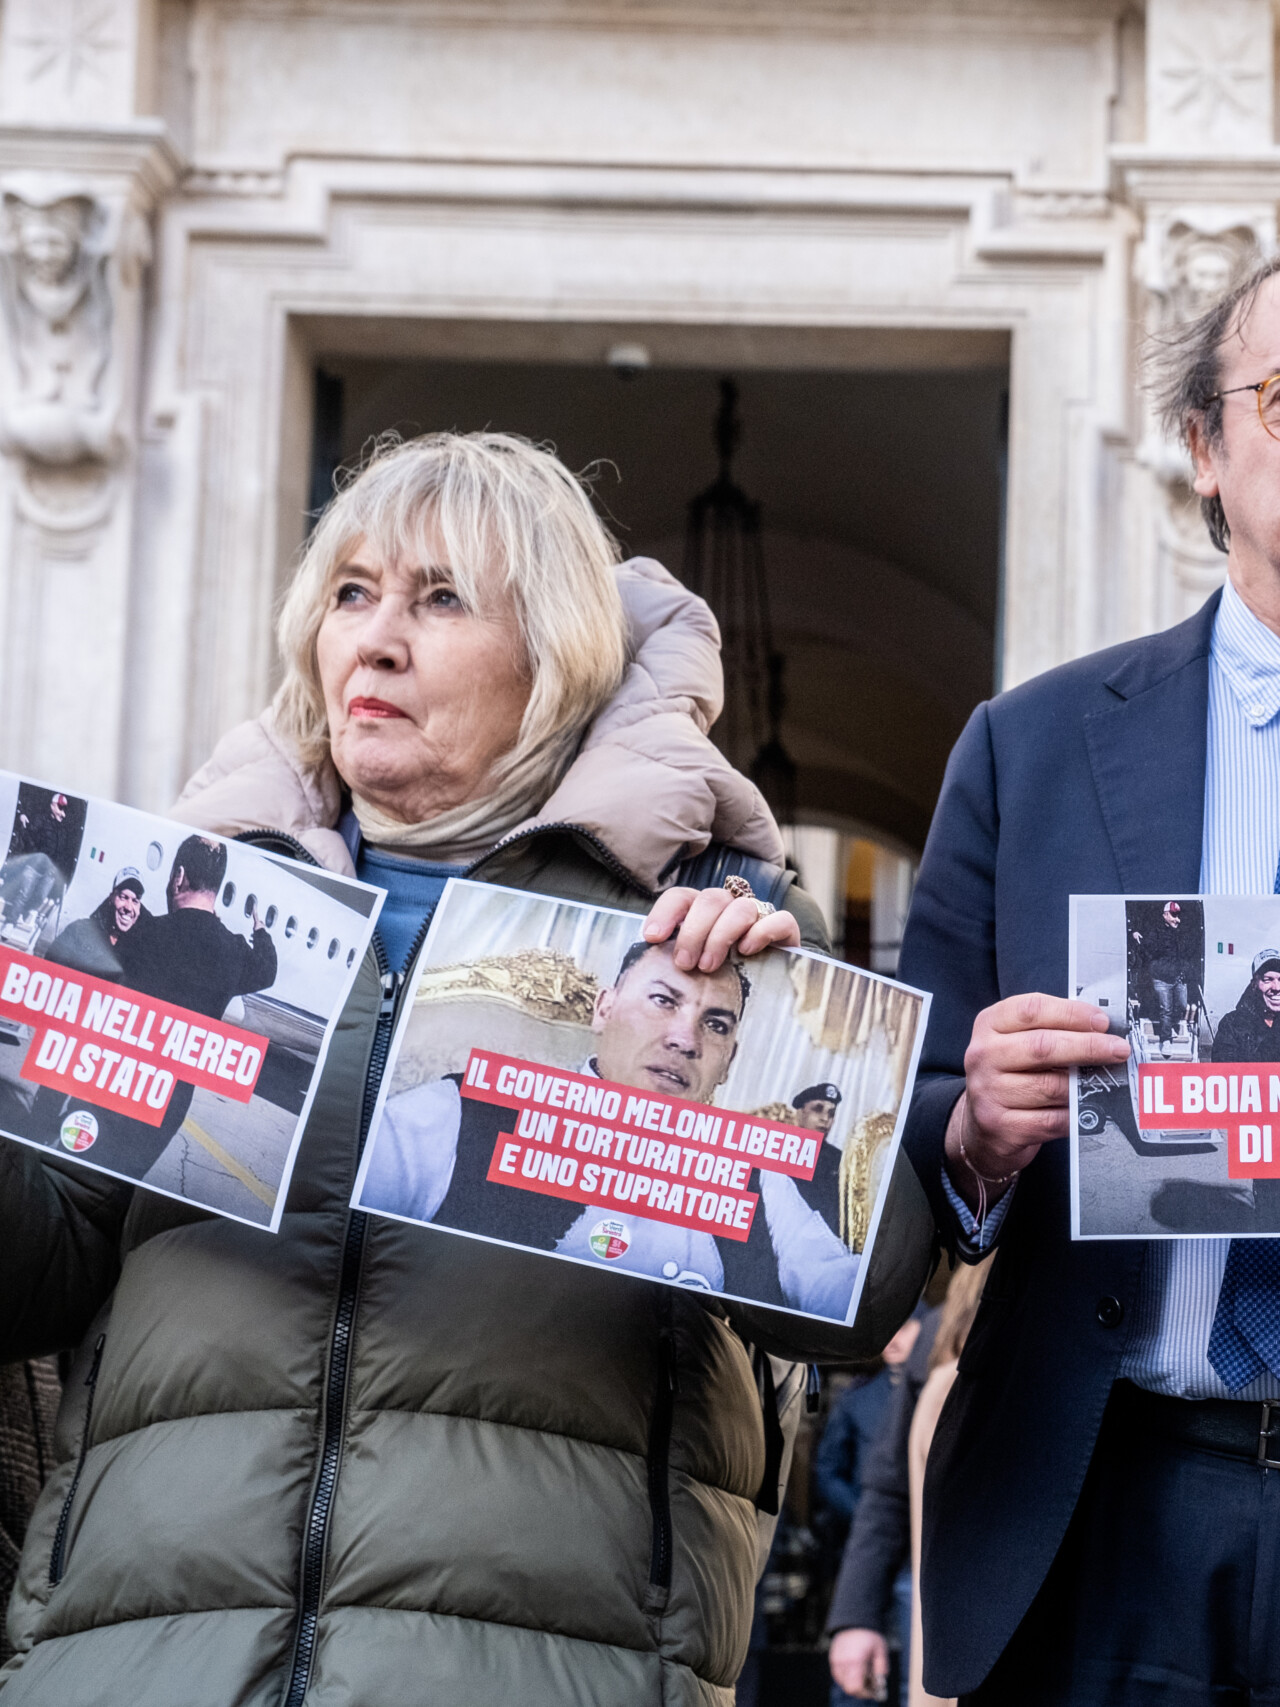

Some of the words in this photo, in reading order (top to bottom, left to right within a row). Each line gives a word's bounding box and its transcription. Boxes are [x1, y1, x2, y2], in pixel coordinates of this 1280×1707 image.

[0, 962, 84, 1024] BOIA
[80, 990, 262, 1086] NELL'AEREO
[34, 1028, 78, 1075] DI
[72, 1042, 174, 1110] STATO
[1142, 1075, 1175, 1114] IL
[1181, 1075, 1263, 1114] BOIA
[466, 1057, 491, 1090] IL
[495, 1065, 622, 1121] GOVERNO
[622, 1095, 723, 1146] MELONI
[722, 1120, 818, 1169] LIBERA
[517, 1108, 559, 1144] UN
[561, 1118, 751, 1191] TORTURATORE
[1238, 1124, 1273, 1163] DI
[498, 1142, 522, 1174] E
[521, 1148, 579, 1187] UNO
[579, 1162, 755, 1230] STUPRATORE
